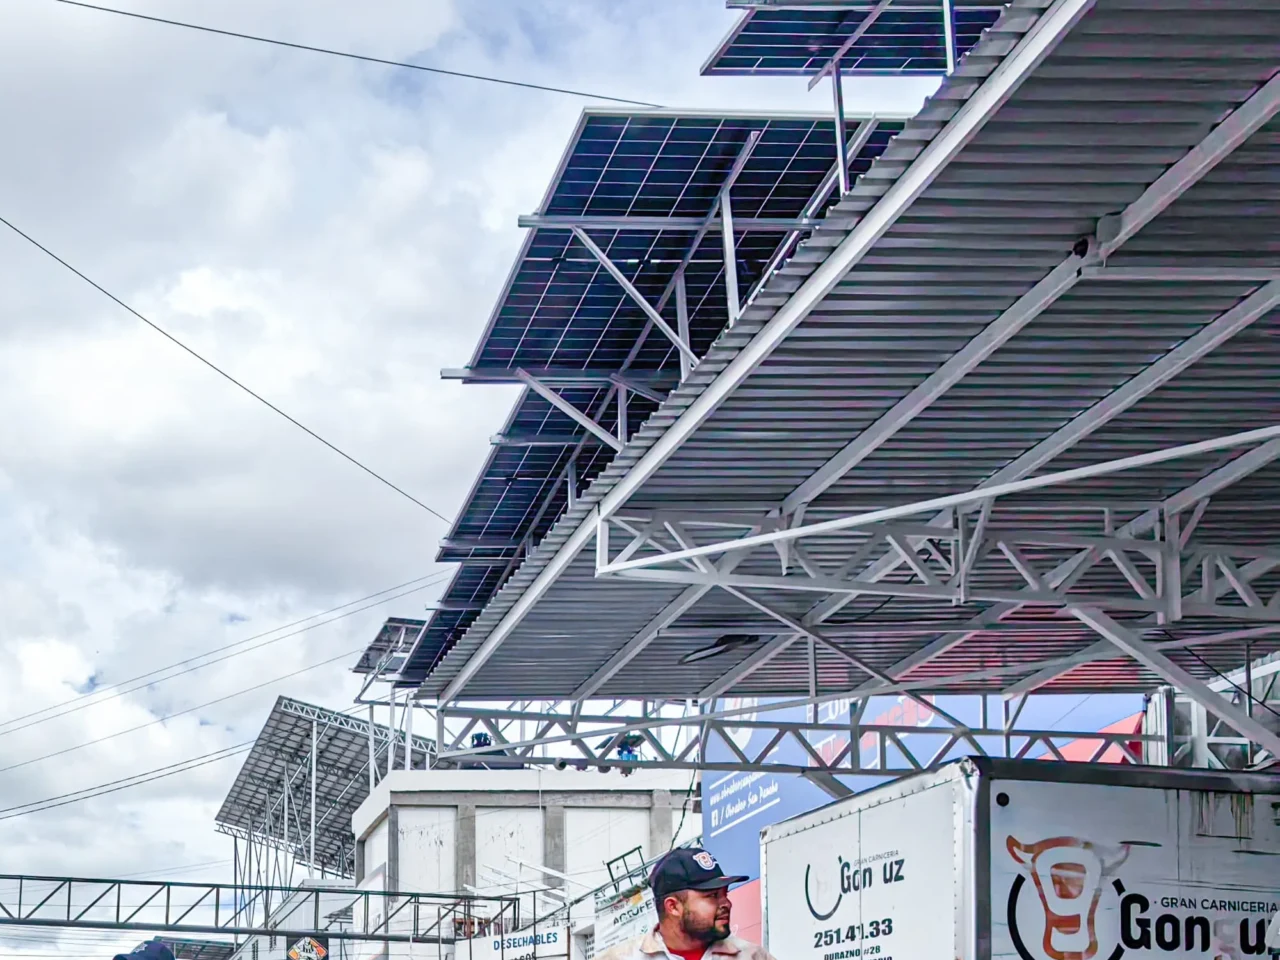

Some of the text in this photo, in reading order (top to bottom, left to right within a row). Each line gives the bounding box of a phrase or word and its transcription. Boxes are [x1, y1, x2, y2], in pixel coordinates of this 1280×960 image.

[840, 859, 905, 894] Gonuz
[1160, 897, 1278, 912] GRAN CARNICERIA
[493, 932, 558, 950] DESECHABLES
[814, 918, 893, 948] 251.41.33
[863, 945, 881, 956] #28
